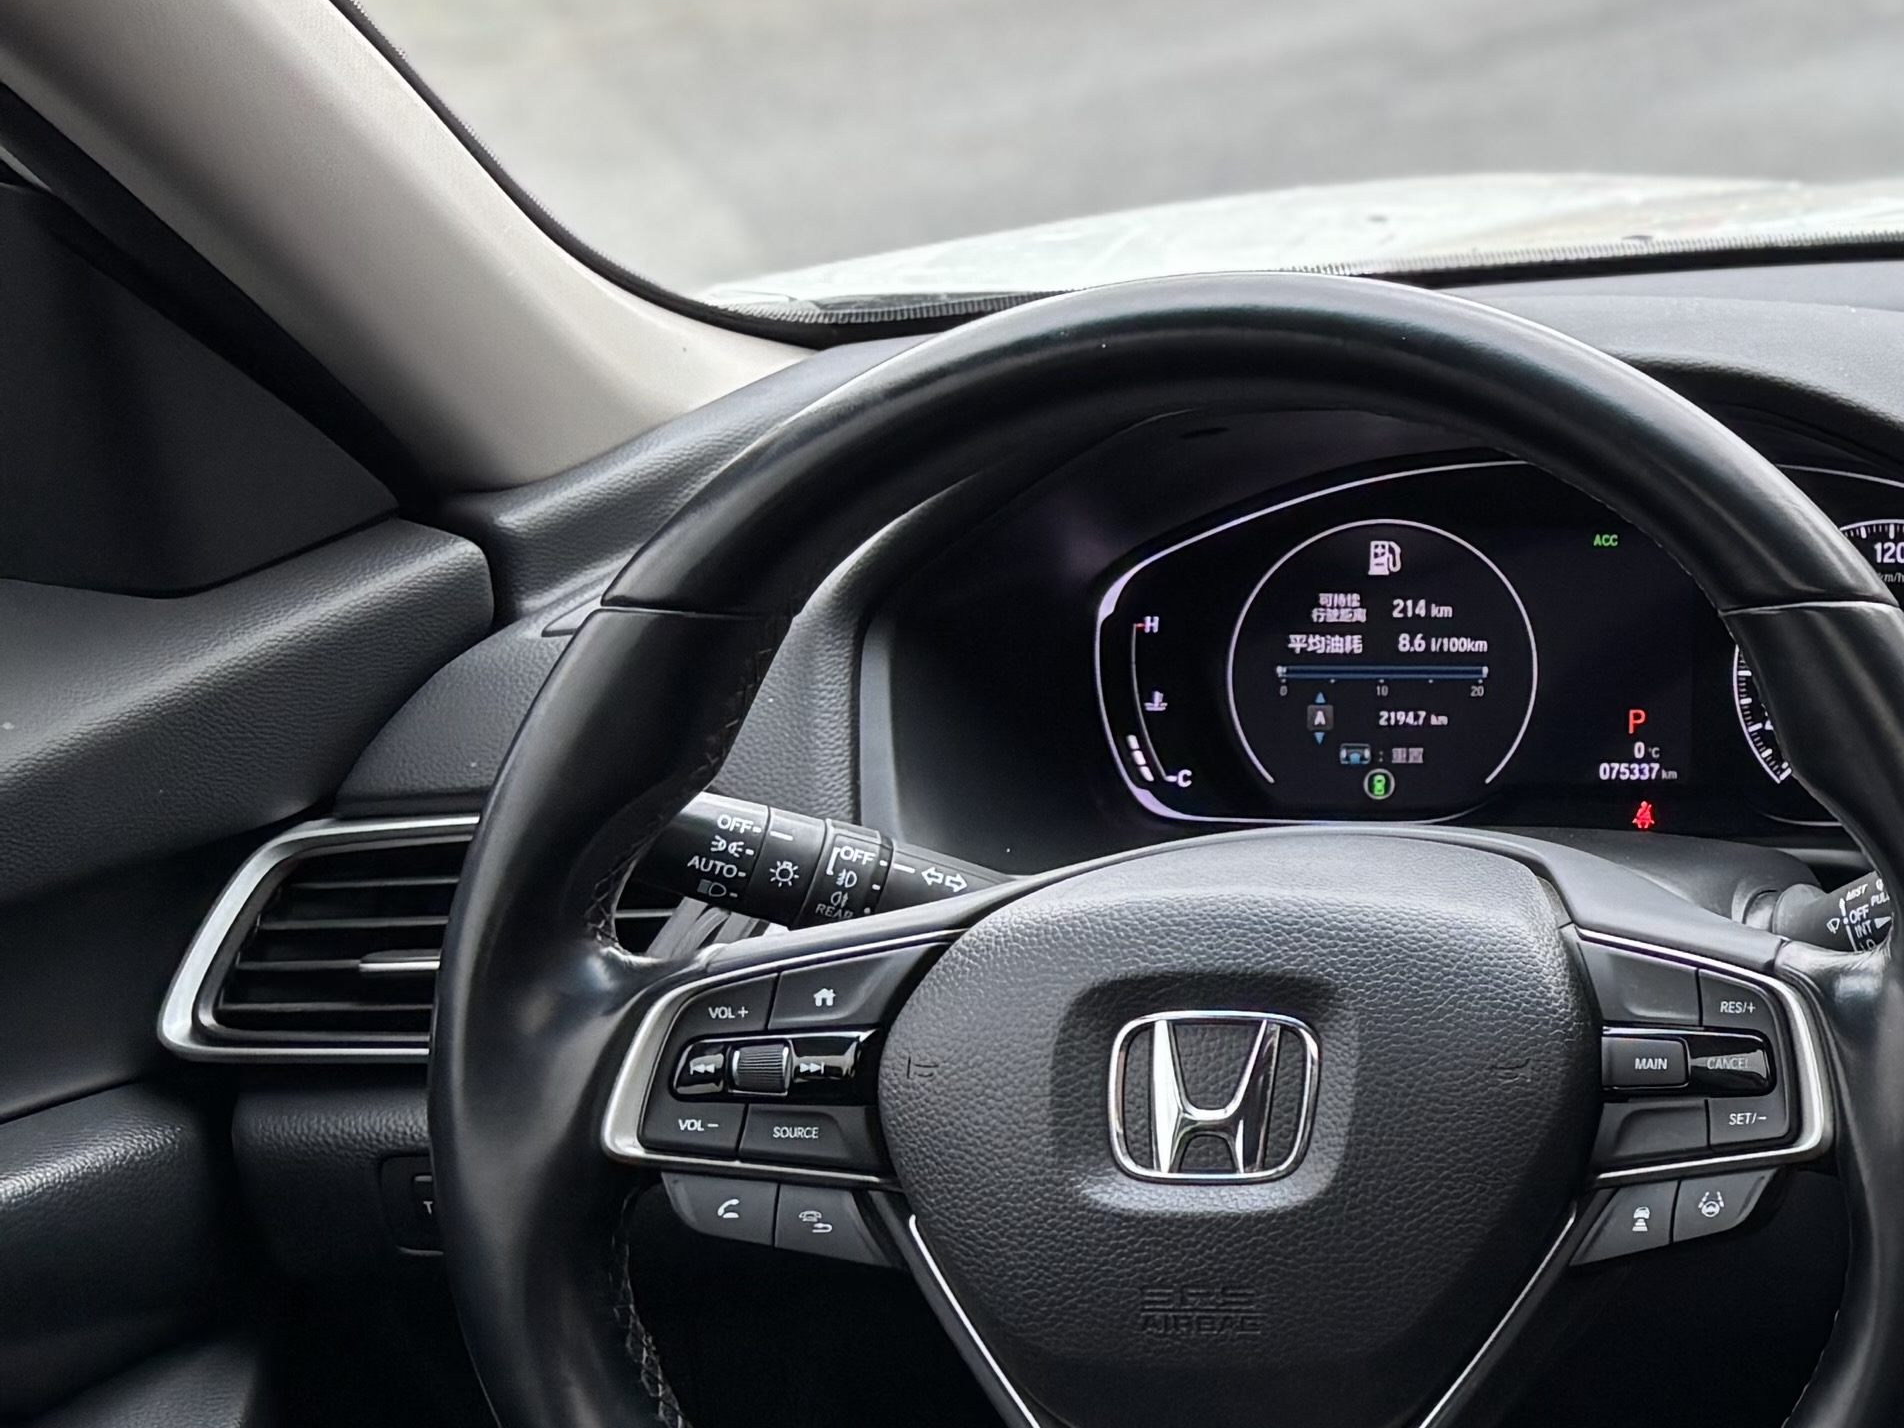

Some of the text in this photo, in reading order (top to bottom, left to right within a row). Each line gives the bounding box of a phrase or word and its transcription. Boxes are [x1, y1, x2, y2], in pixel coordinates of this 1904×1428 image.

[1593, 534, 1619, 547] ACC
[1391, 598, 1453, 618] 214 km
[1144, 617, 1159, 633] H
[1287, 634, 1363, 654] 平均油耗
[1397, 633, 1426, 653] 8.6
[1279, 685, 1484, 697] 0 10 20
[1313, 710, 1326, 725] A
[1378, 710, 1449, 726] 2194.7 km
[1628, 709, 1646, 734] P
[1633, 741, 1645, 759] 0
[1177, 770, 1192, 788] C
[1599, 762, 1678, 781] 075337 km
[717, 814, 755, 834] OFF
[839, 845, 877, 866] OFF
[687, 855, 738, 878] AUTO
[1849, 903, 1870, 924] OFF
[1854, 919, 1873, 939] INT
[1634, 1057, 1668, 1070] MAIN
[772, 1126, 819, 1139] SOURCE
